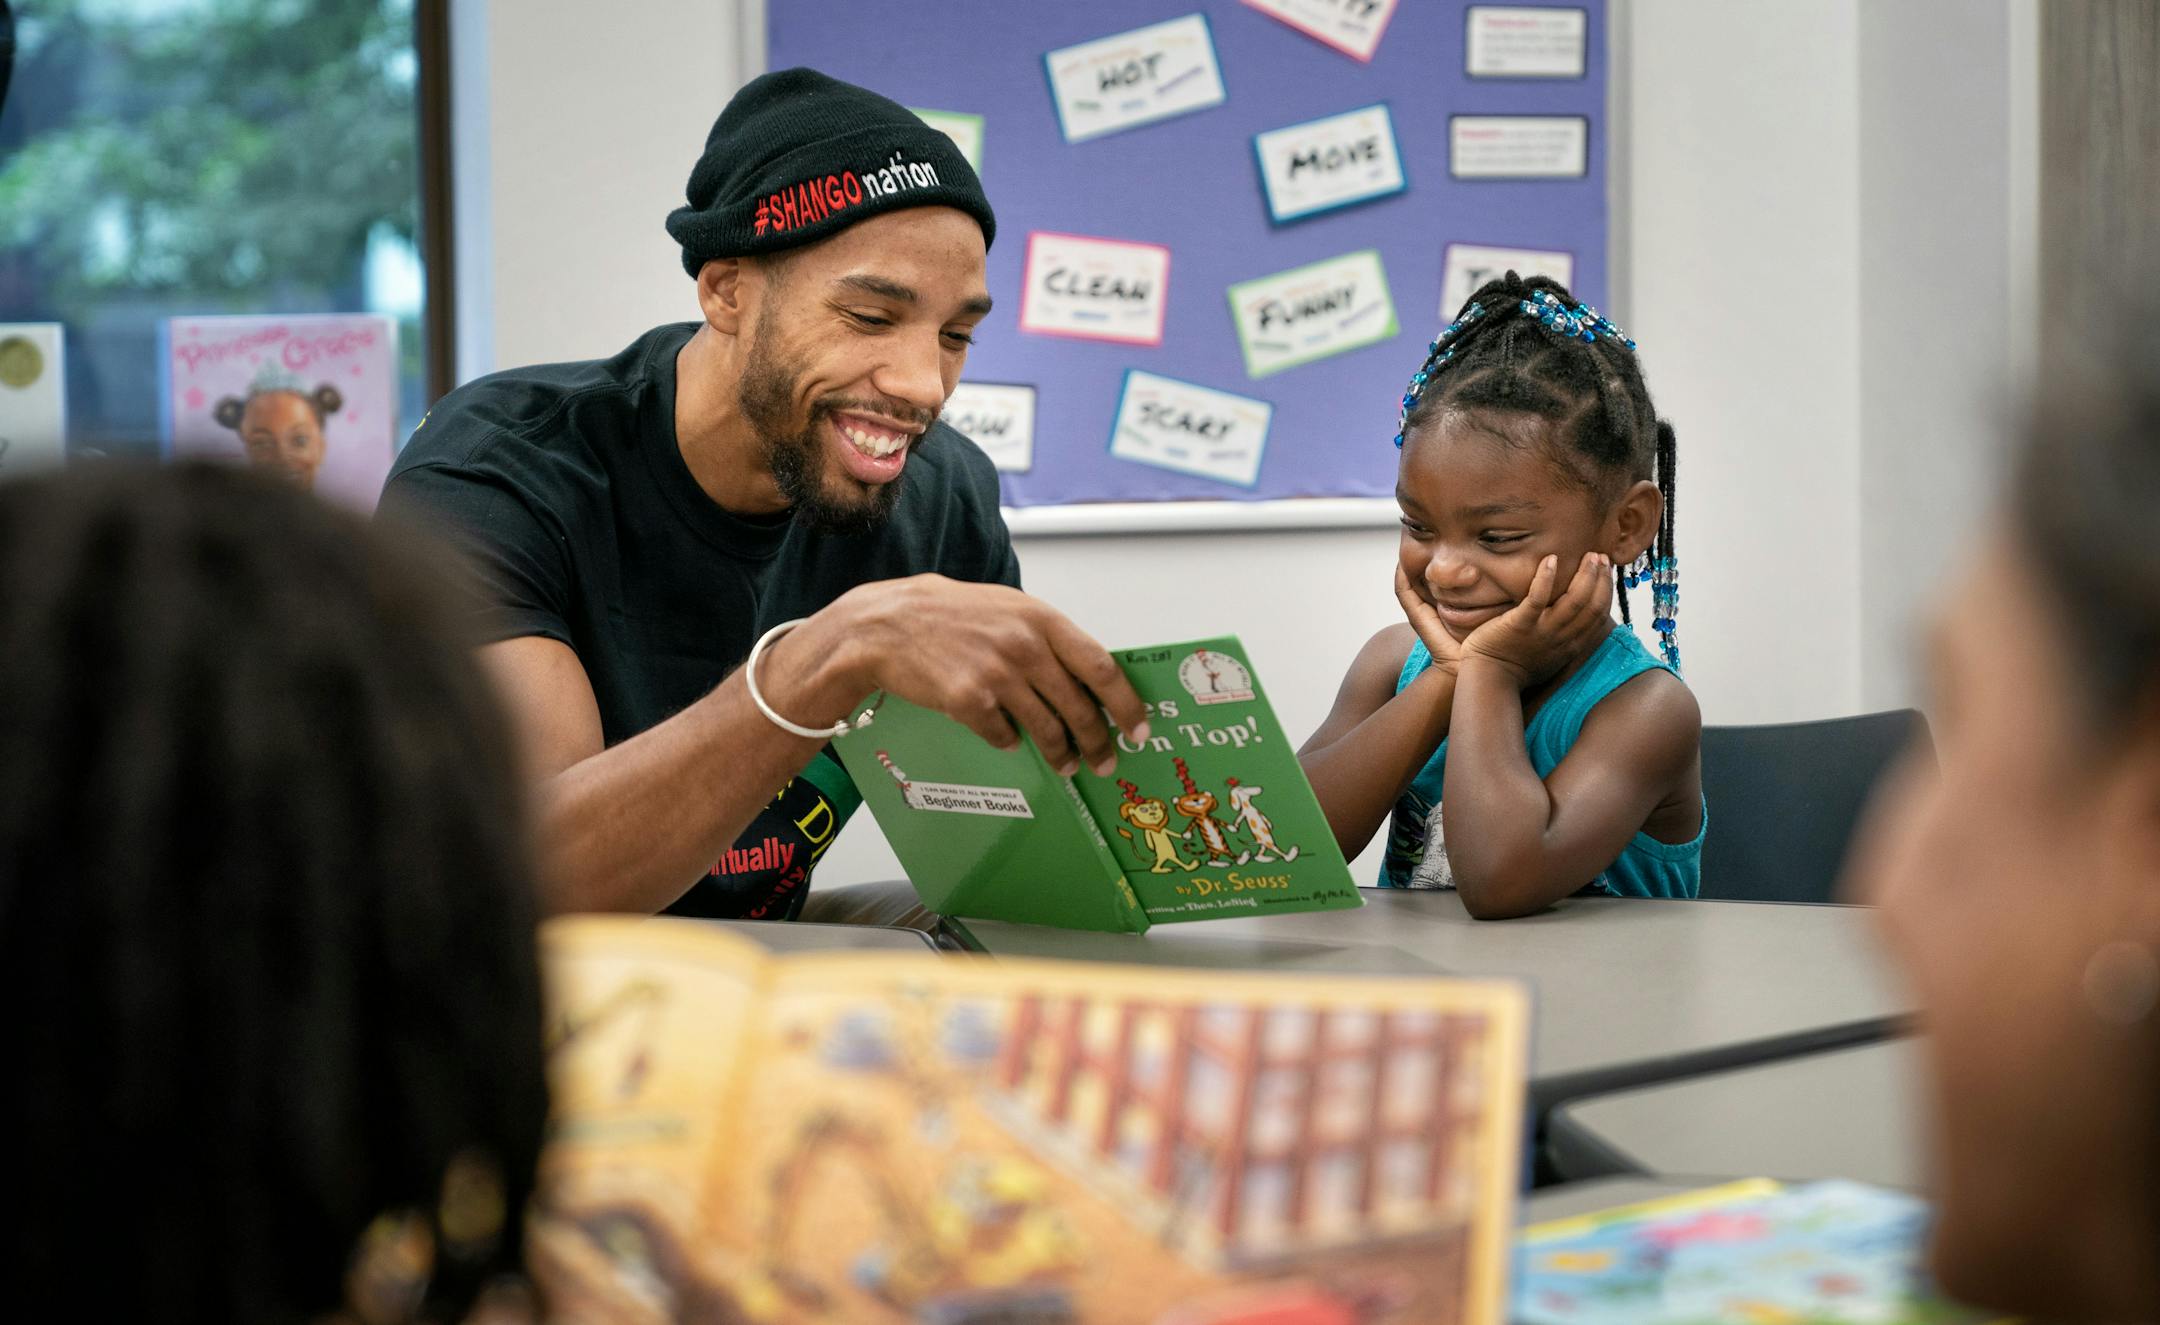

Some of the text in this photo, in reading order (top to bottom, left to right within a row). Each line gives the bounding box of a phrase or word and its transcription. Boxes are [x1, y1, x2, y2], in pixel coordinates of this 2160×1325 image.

[1097, 52, 1164, 92] HOT
[754, 151, 941, 237] #SHANGO nation
[1044, 266, 1153, 300] CLEAN
[1258, 281, 1357, 333] FUNNY
[943, 411, 1015, 436] OW
[1139, 401, 1237, 441] SCARY
[1117, 716, 1263, 753] On Top!
[922, 794, 1028, 813] Beginner Books
[1191, 878, 1228, 897] Dr.
